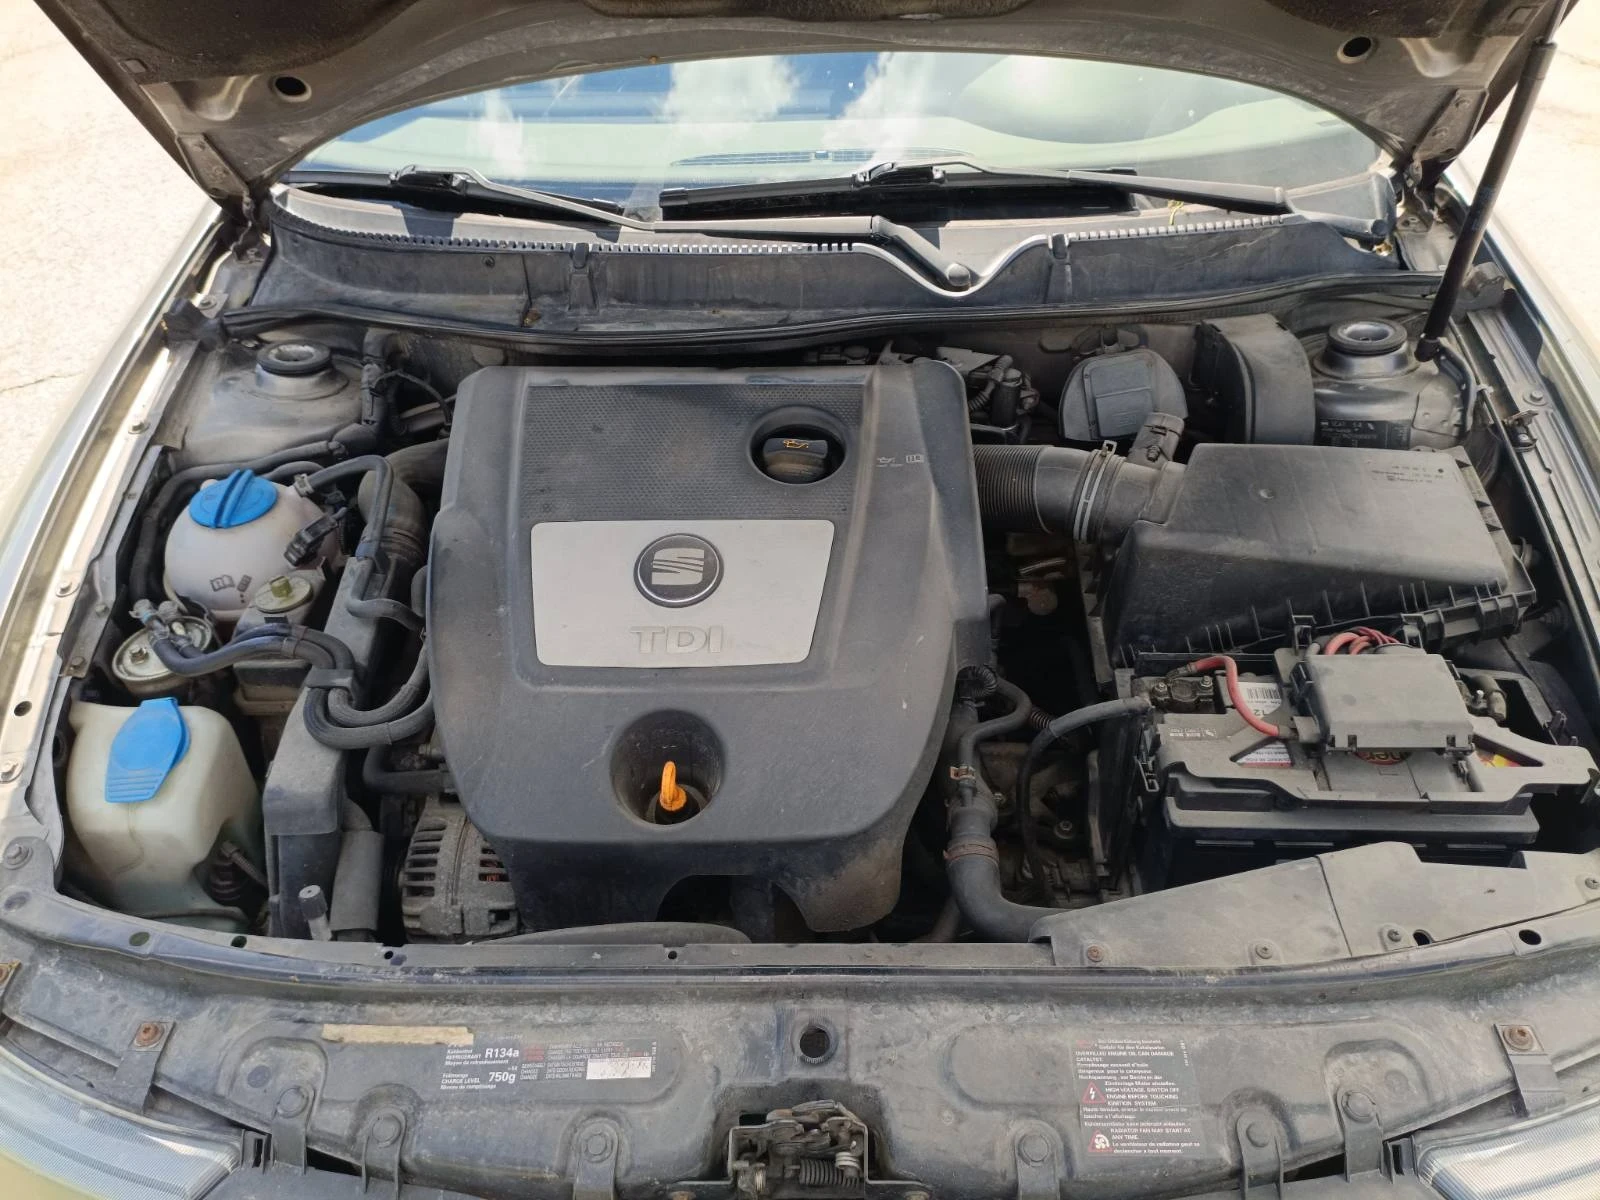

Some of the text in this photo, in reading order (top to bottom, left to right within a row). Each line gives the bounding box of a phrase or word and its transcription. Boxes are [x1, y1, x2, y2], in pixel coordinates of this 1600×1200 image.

[630, 625, 723, 654] TDI
[484, 1047, 520, 1058] R134a
[488, 1072, 516, 1084] 750g
